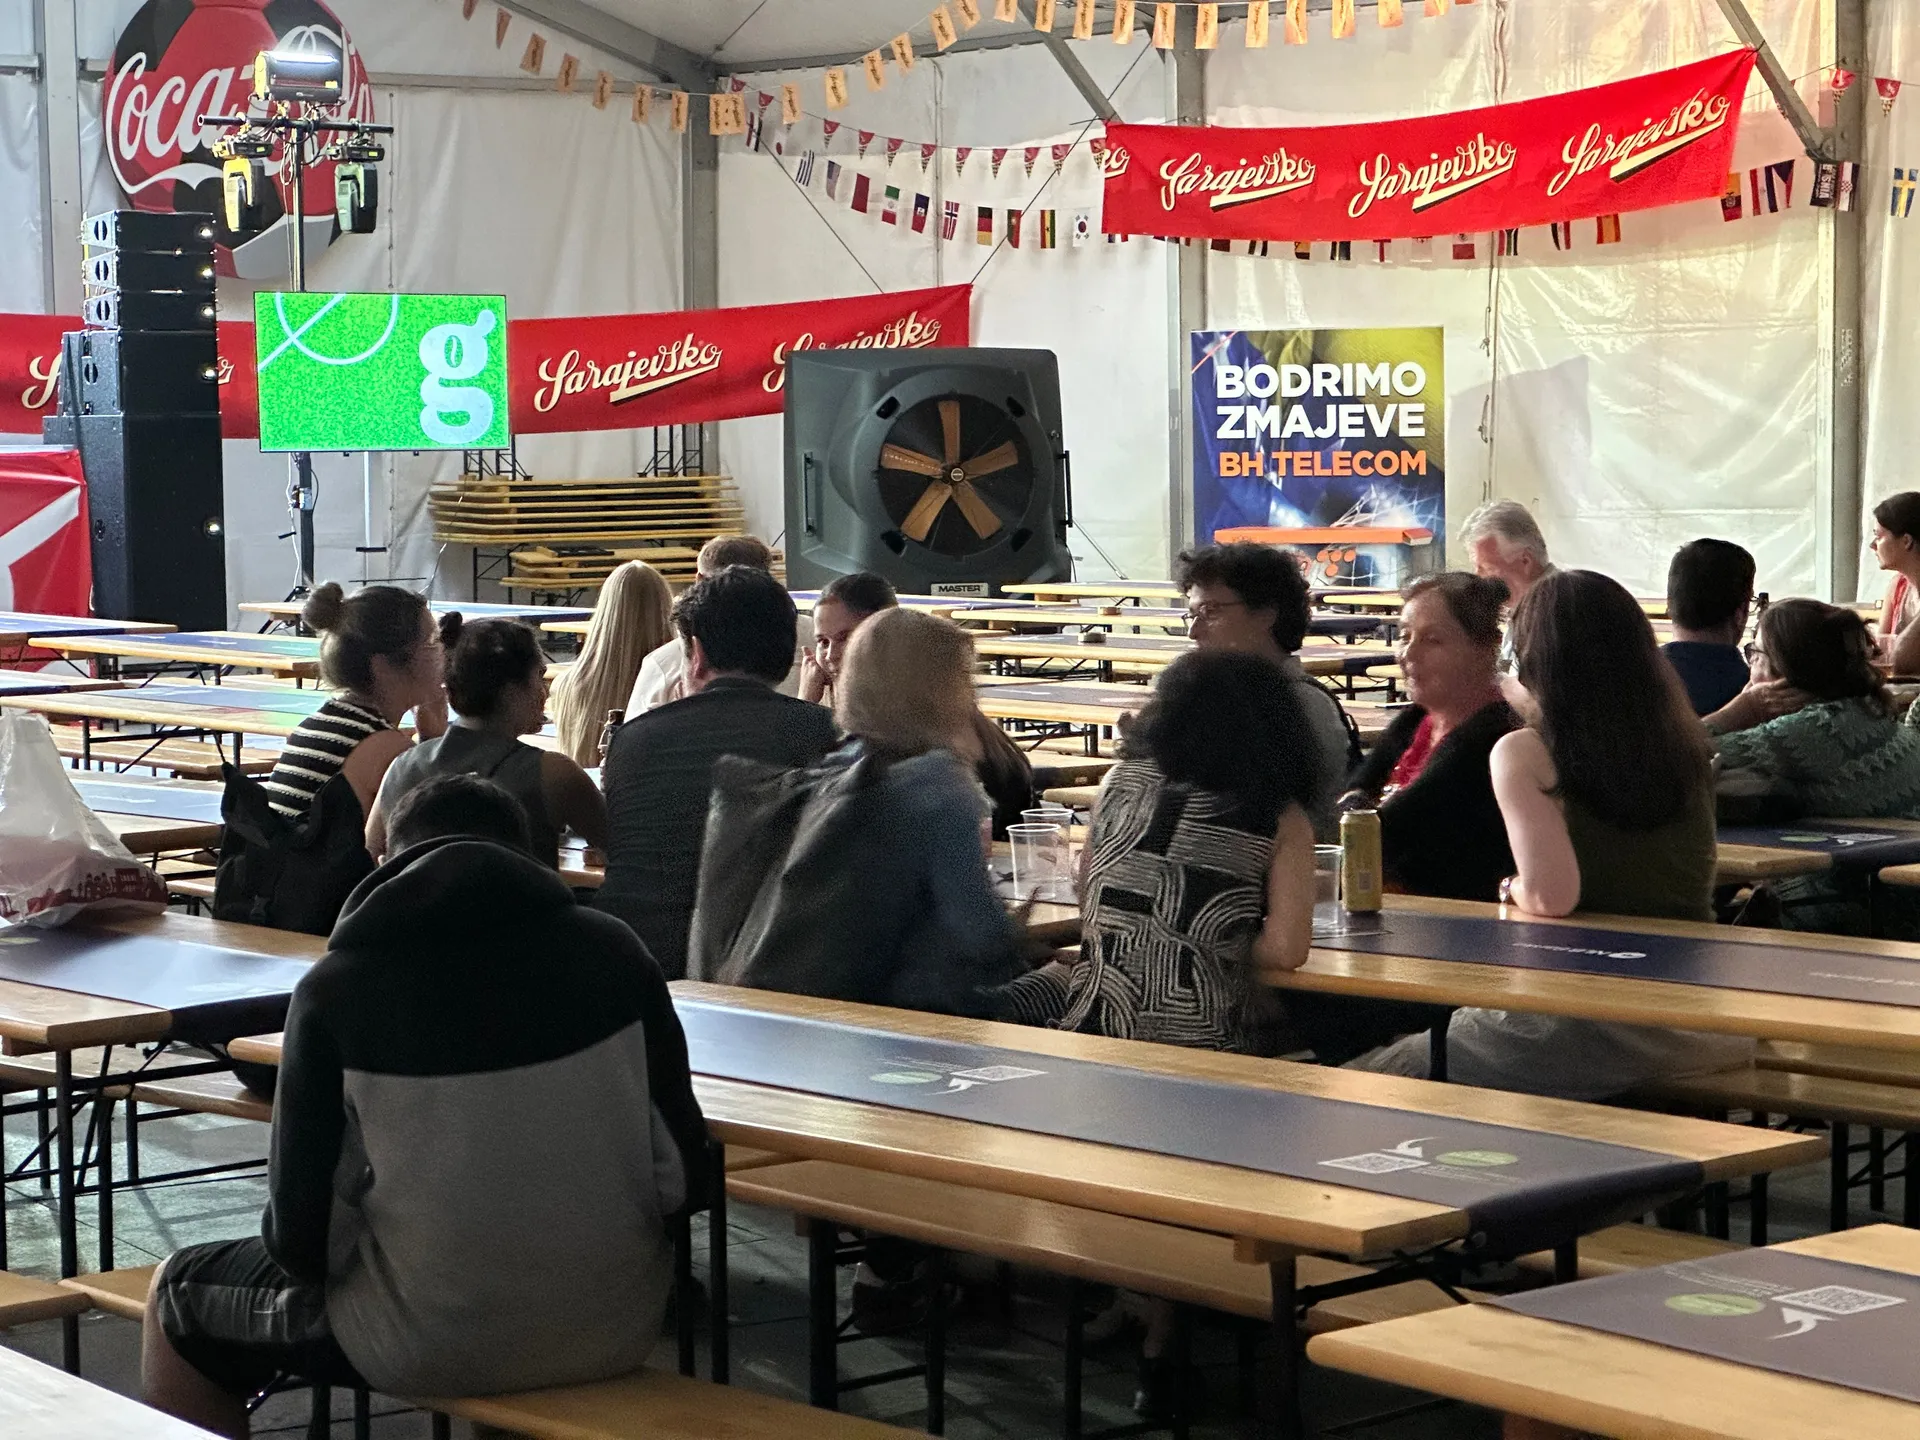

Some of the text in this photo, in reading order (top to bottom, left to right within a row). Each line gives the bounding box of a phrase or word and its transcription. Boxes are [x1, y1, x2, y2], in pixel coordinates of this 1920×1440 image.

[1547, 87, 1732, 197] Sarajevsko
[1159, 147, 1317, 212] Sarajevsko
[1348, 131, 1518, 218] Sarajevsko
[533, 332, 723, 413] Sarajevsko
[1216, 361, 1427, 399] BODRIMO
[1216, 403, 1426, 439] ZMAJEVE
[1219, 450, 1427, 477] BH TELECOM
[938, 584, 981, 593] MASTER
